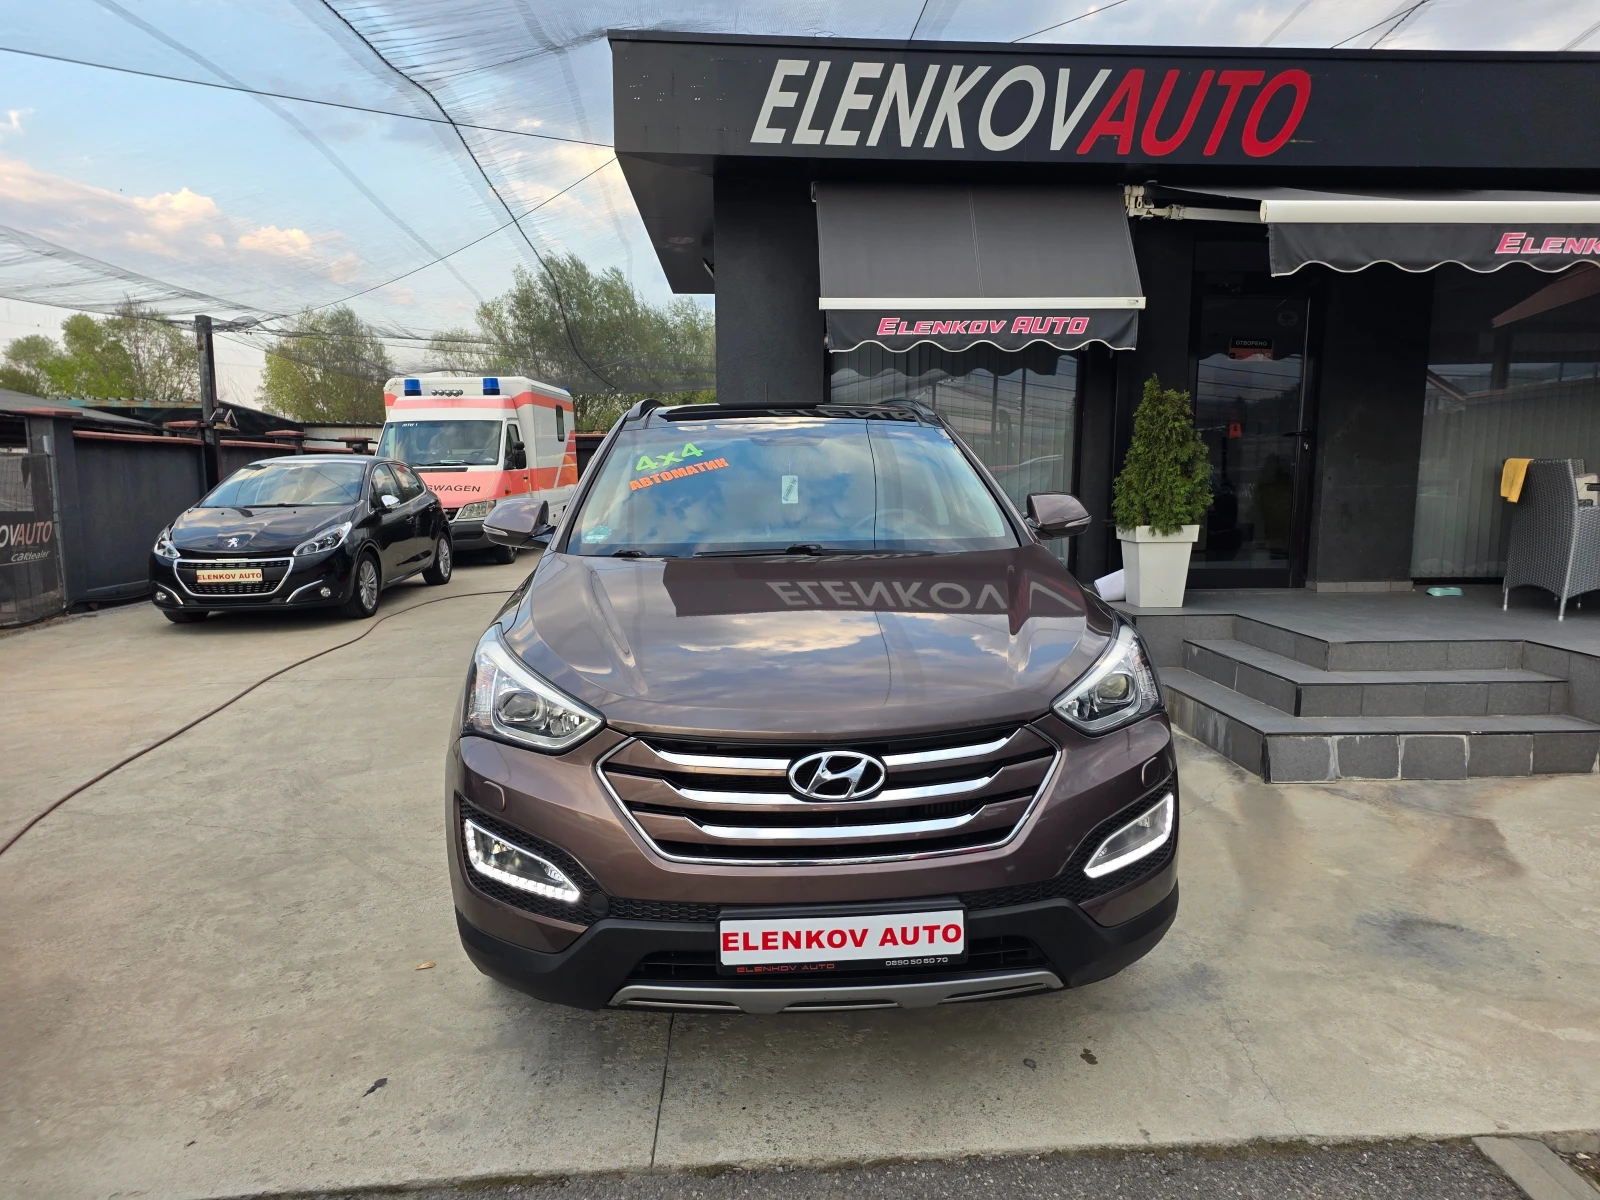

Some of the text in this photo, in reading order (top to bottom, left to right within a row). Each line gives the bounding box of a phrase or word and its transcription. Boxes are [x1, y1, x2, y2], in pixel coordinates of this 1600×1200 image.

[1011, 316, 1090, 335] AUTO
[635, 442, 704, 471] 4x4
[629, 457, 730, 491] АВТОМАТИК
[722, 923, 962, 952] ELENKOV AUTO
[736, 963, 835, 973] ELENKOV AUTO
